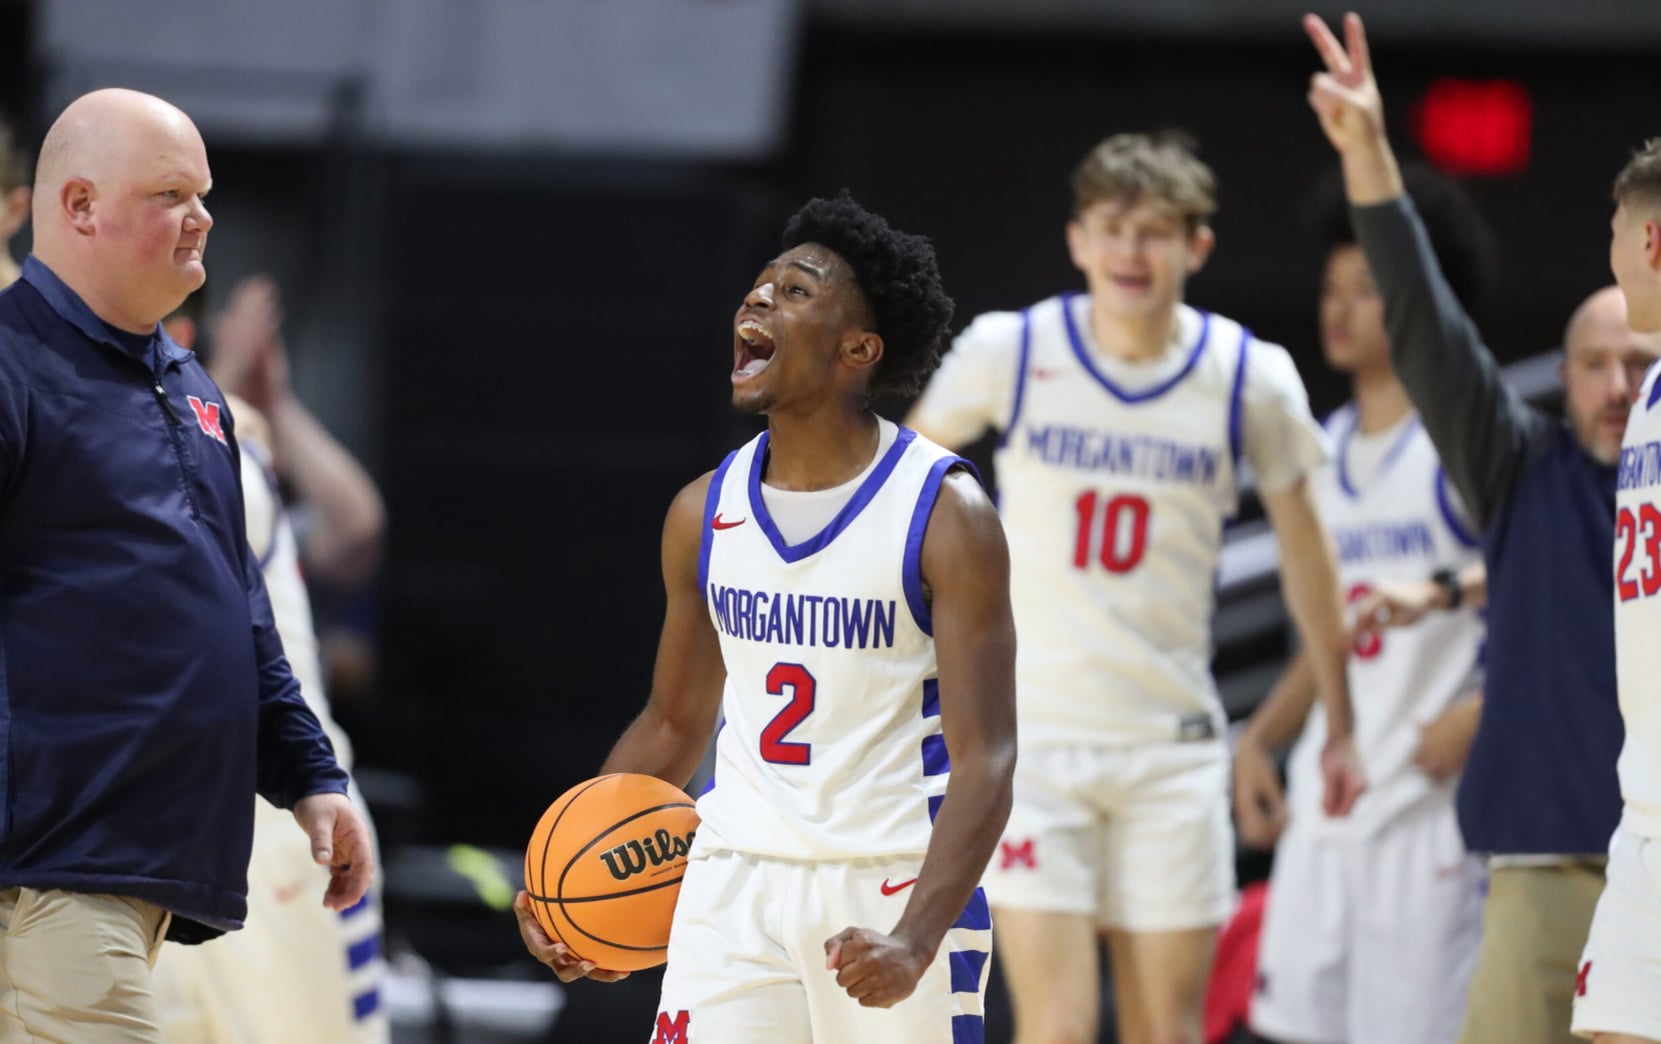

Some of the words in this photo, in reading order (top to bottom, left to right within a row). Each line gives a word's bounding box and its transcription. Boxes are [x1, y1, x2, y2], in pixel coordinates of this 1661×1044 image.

[186, 395, 228, 446] M
[1027, 423, 1221, 484] MORGANTOWN
[1073, 489, 1151, 575] 10
[1616, 502, 1661, 602] 23
[710, 583, 896, 650] MORGANTOWN
[759, 661, 817, 766] 2
[651, 1009, 691, 1044] M
